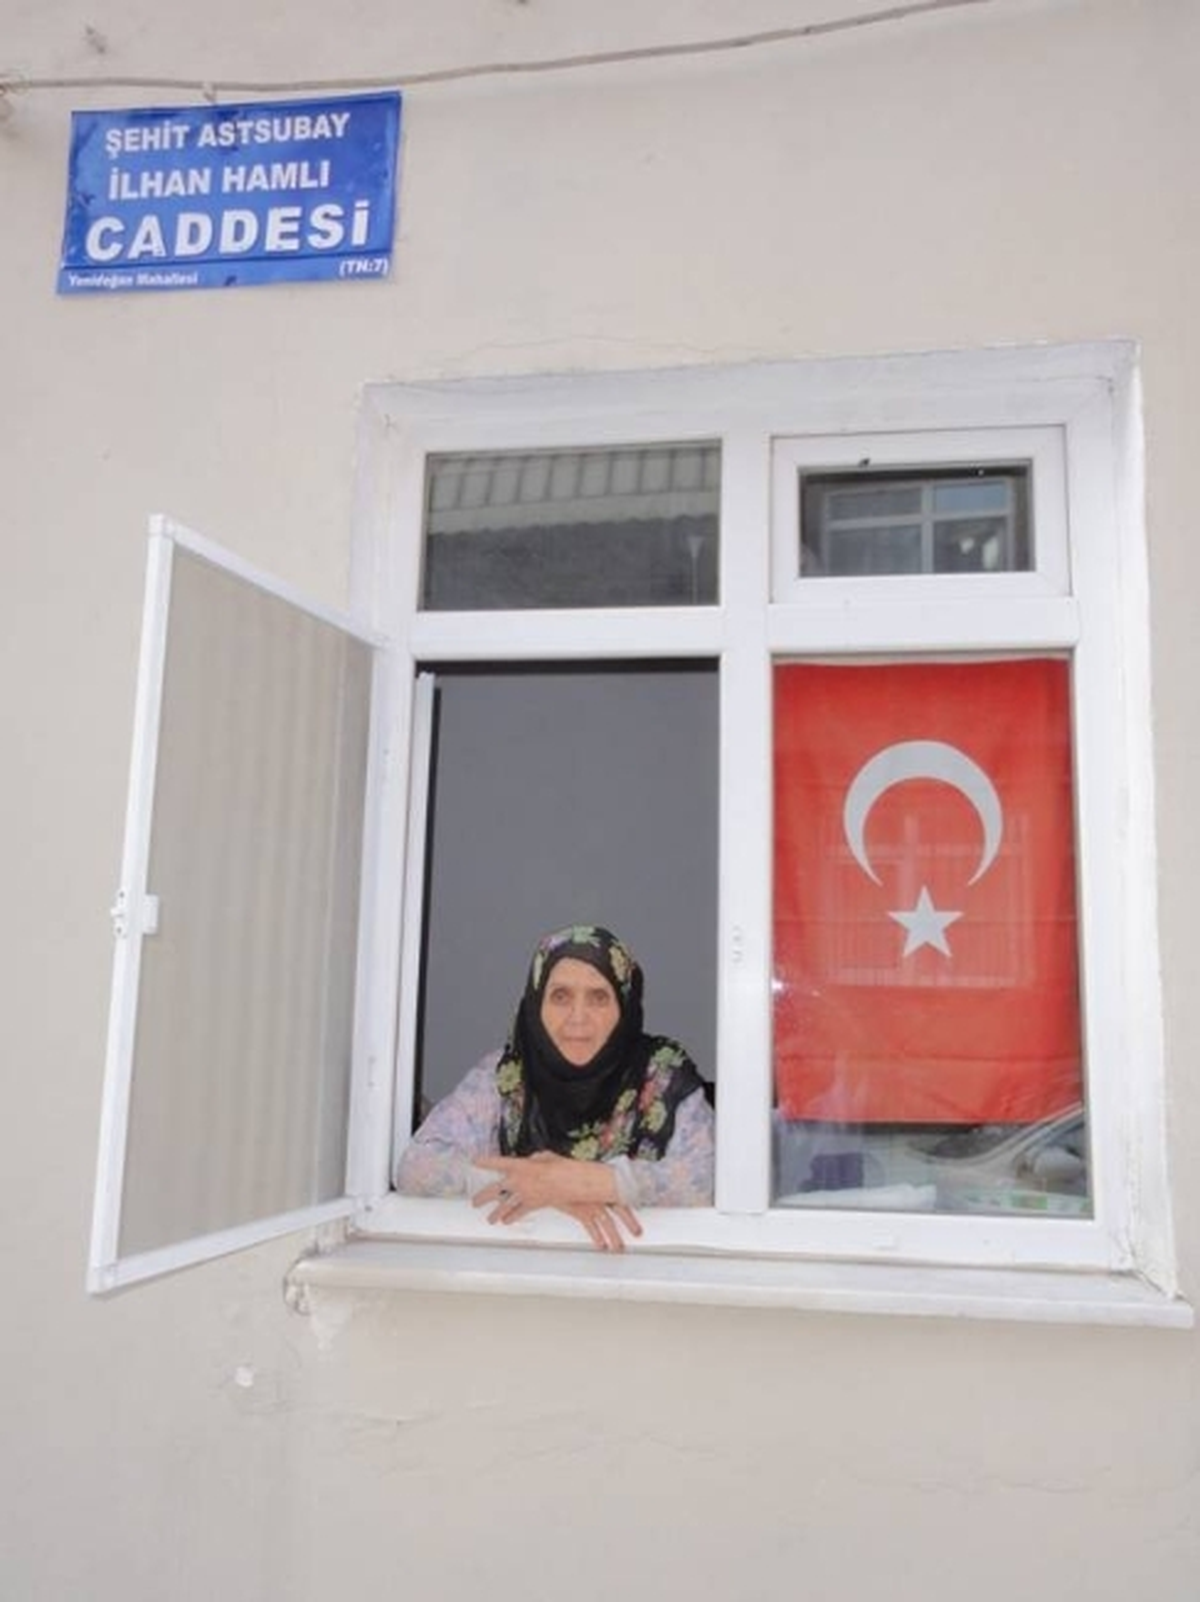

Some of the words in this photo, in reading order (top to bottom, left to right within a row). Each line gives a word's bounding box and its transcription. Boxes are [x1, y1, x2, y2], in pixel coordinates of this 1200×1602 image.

[105, 119, 190, 159] ŞEHİT
[197, 112, 351, 148] ASTSUBAY
[108, 166, 212, 201] İLHAN
[221, 160, 330, 194] HAMLI
